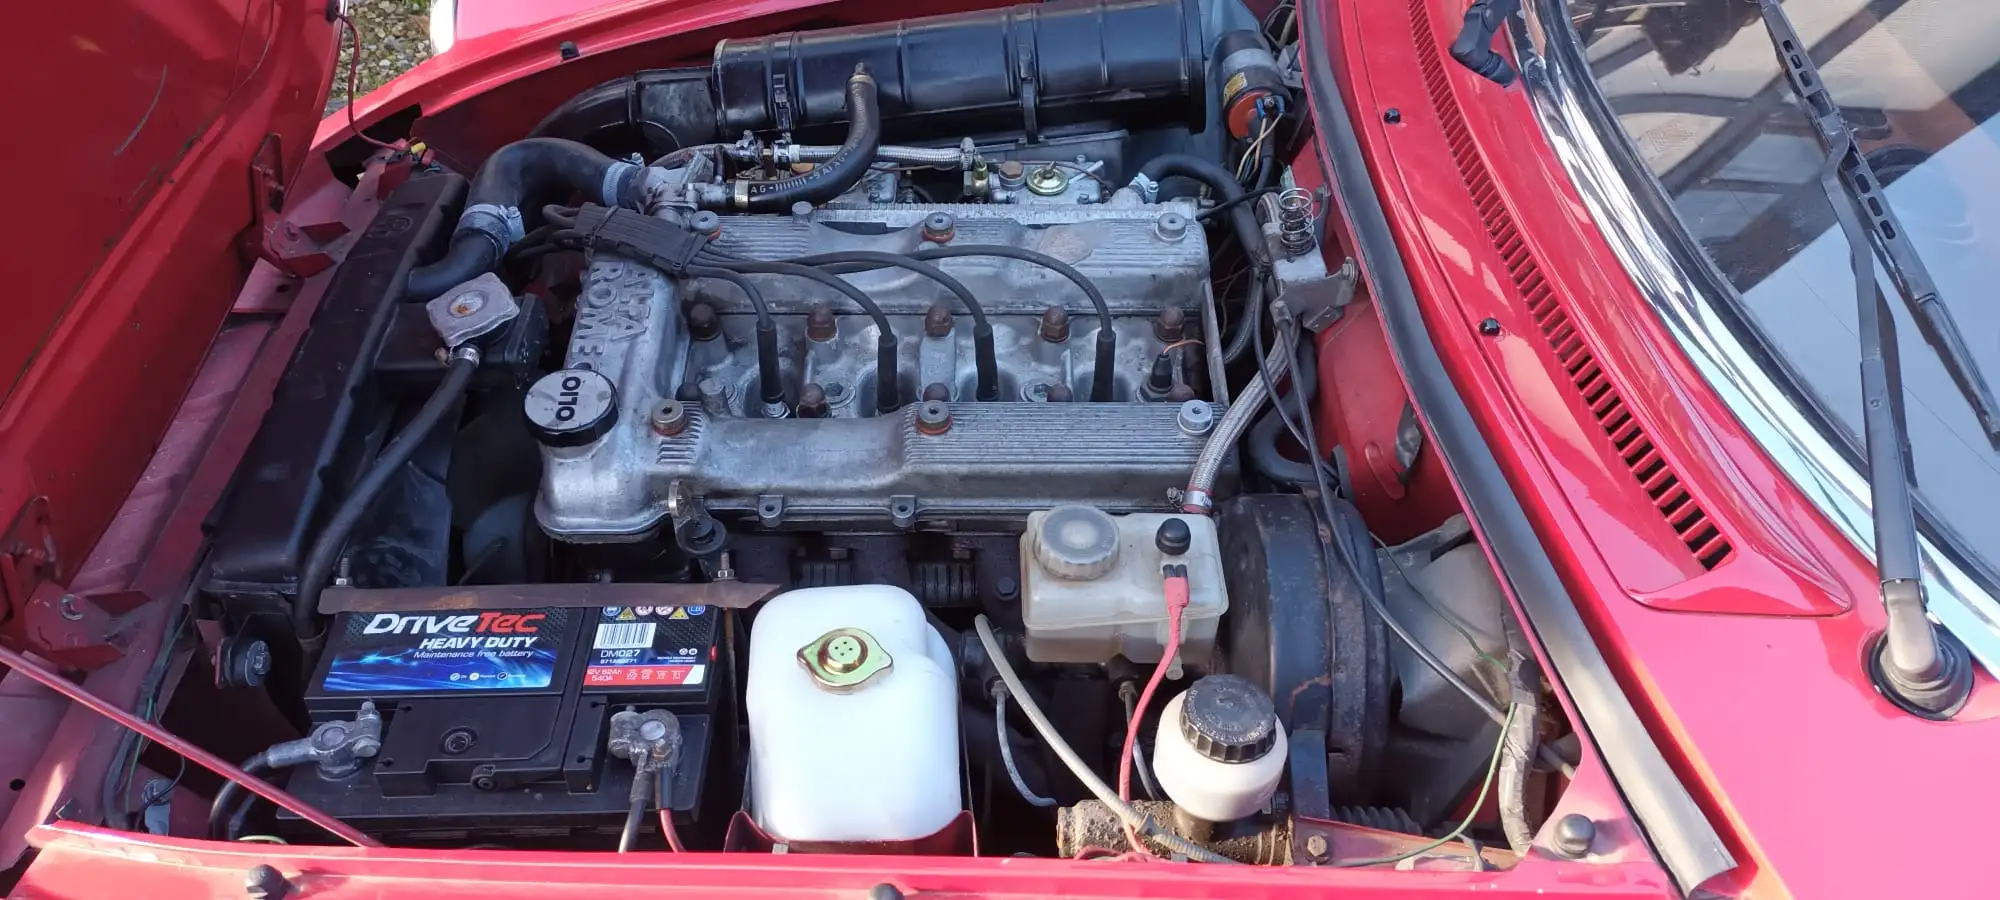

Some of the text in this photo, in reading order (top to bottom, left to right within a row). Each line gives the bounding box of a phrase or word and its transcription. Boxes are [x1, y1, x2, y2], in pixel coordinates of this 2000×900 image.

[555, 376, 581, 421] OLIO
[418, 636, 538, 650] HEAVY DUTY
[413, 650, 534, 659] Maintenance free battery
[600, 649, 641, 658] DM027
